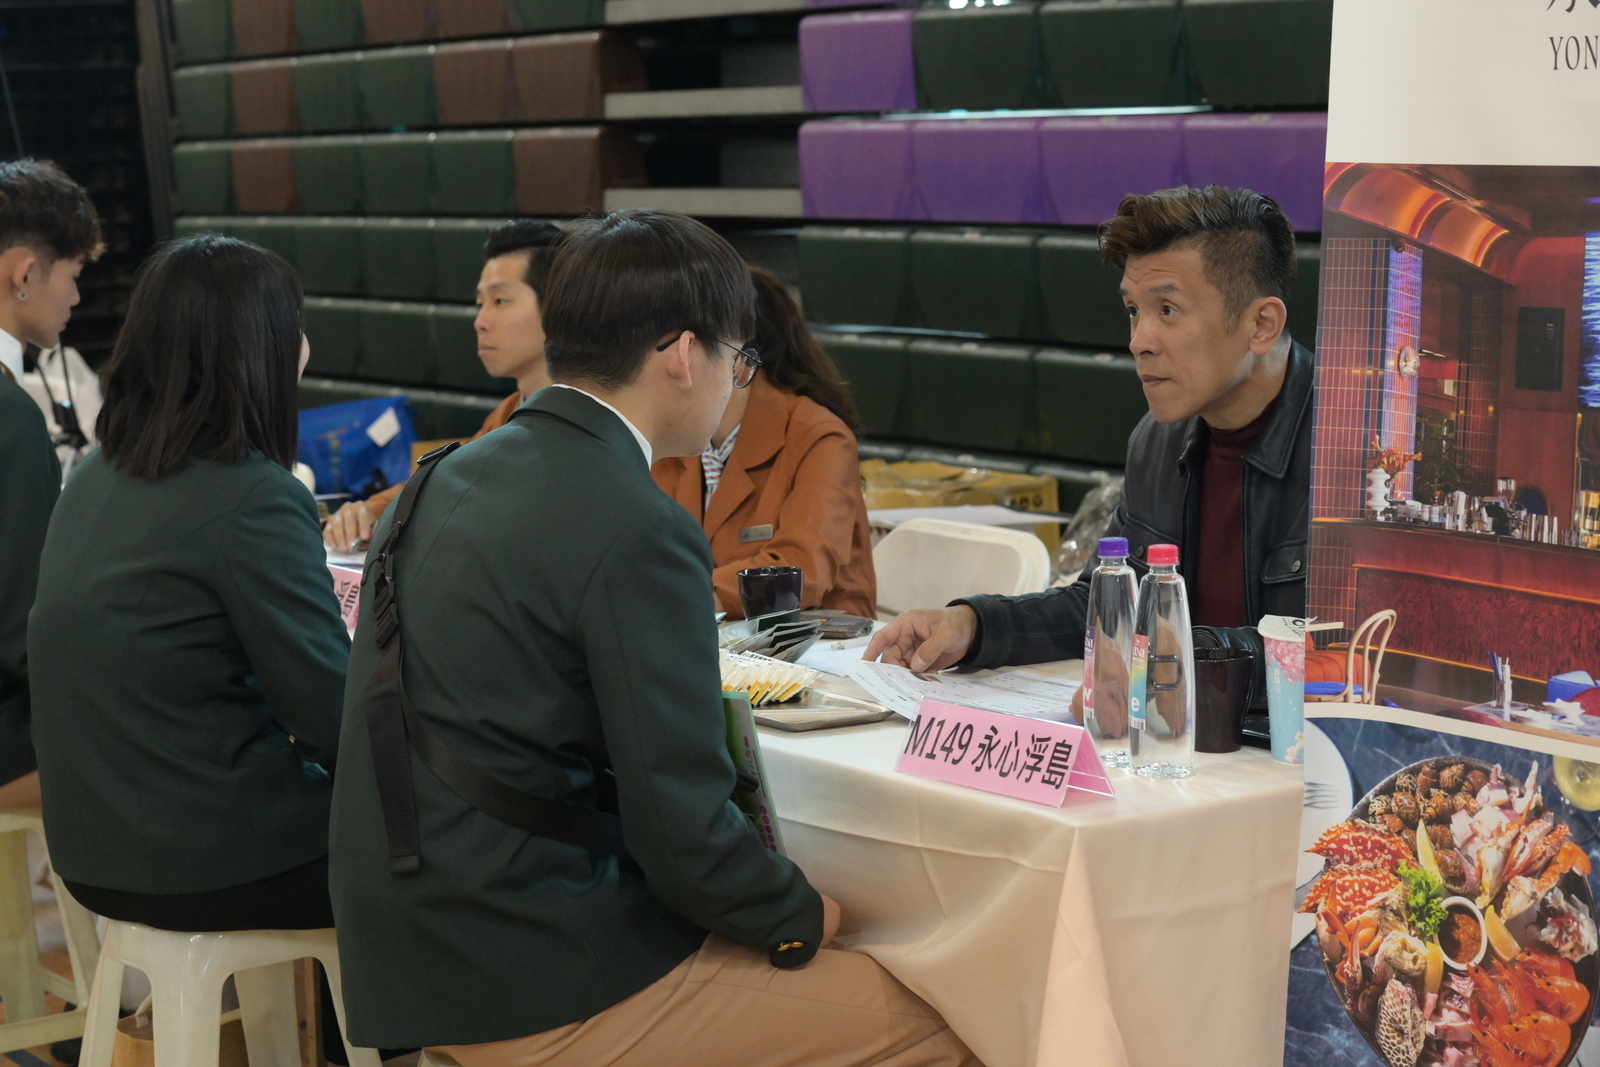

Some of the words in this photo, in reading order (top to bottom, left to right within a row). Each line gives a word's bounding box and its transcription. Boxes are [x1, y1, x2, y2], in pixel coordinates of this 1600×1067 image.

[1549, 35, 1599, 71] YON
[903, 714, 975, 766] M149
[971, 724, 1074, 790] 永心浮島
